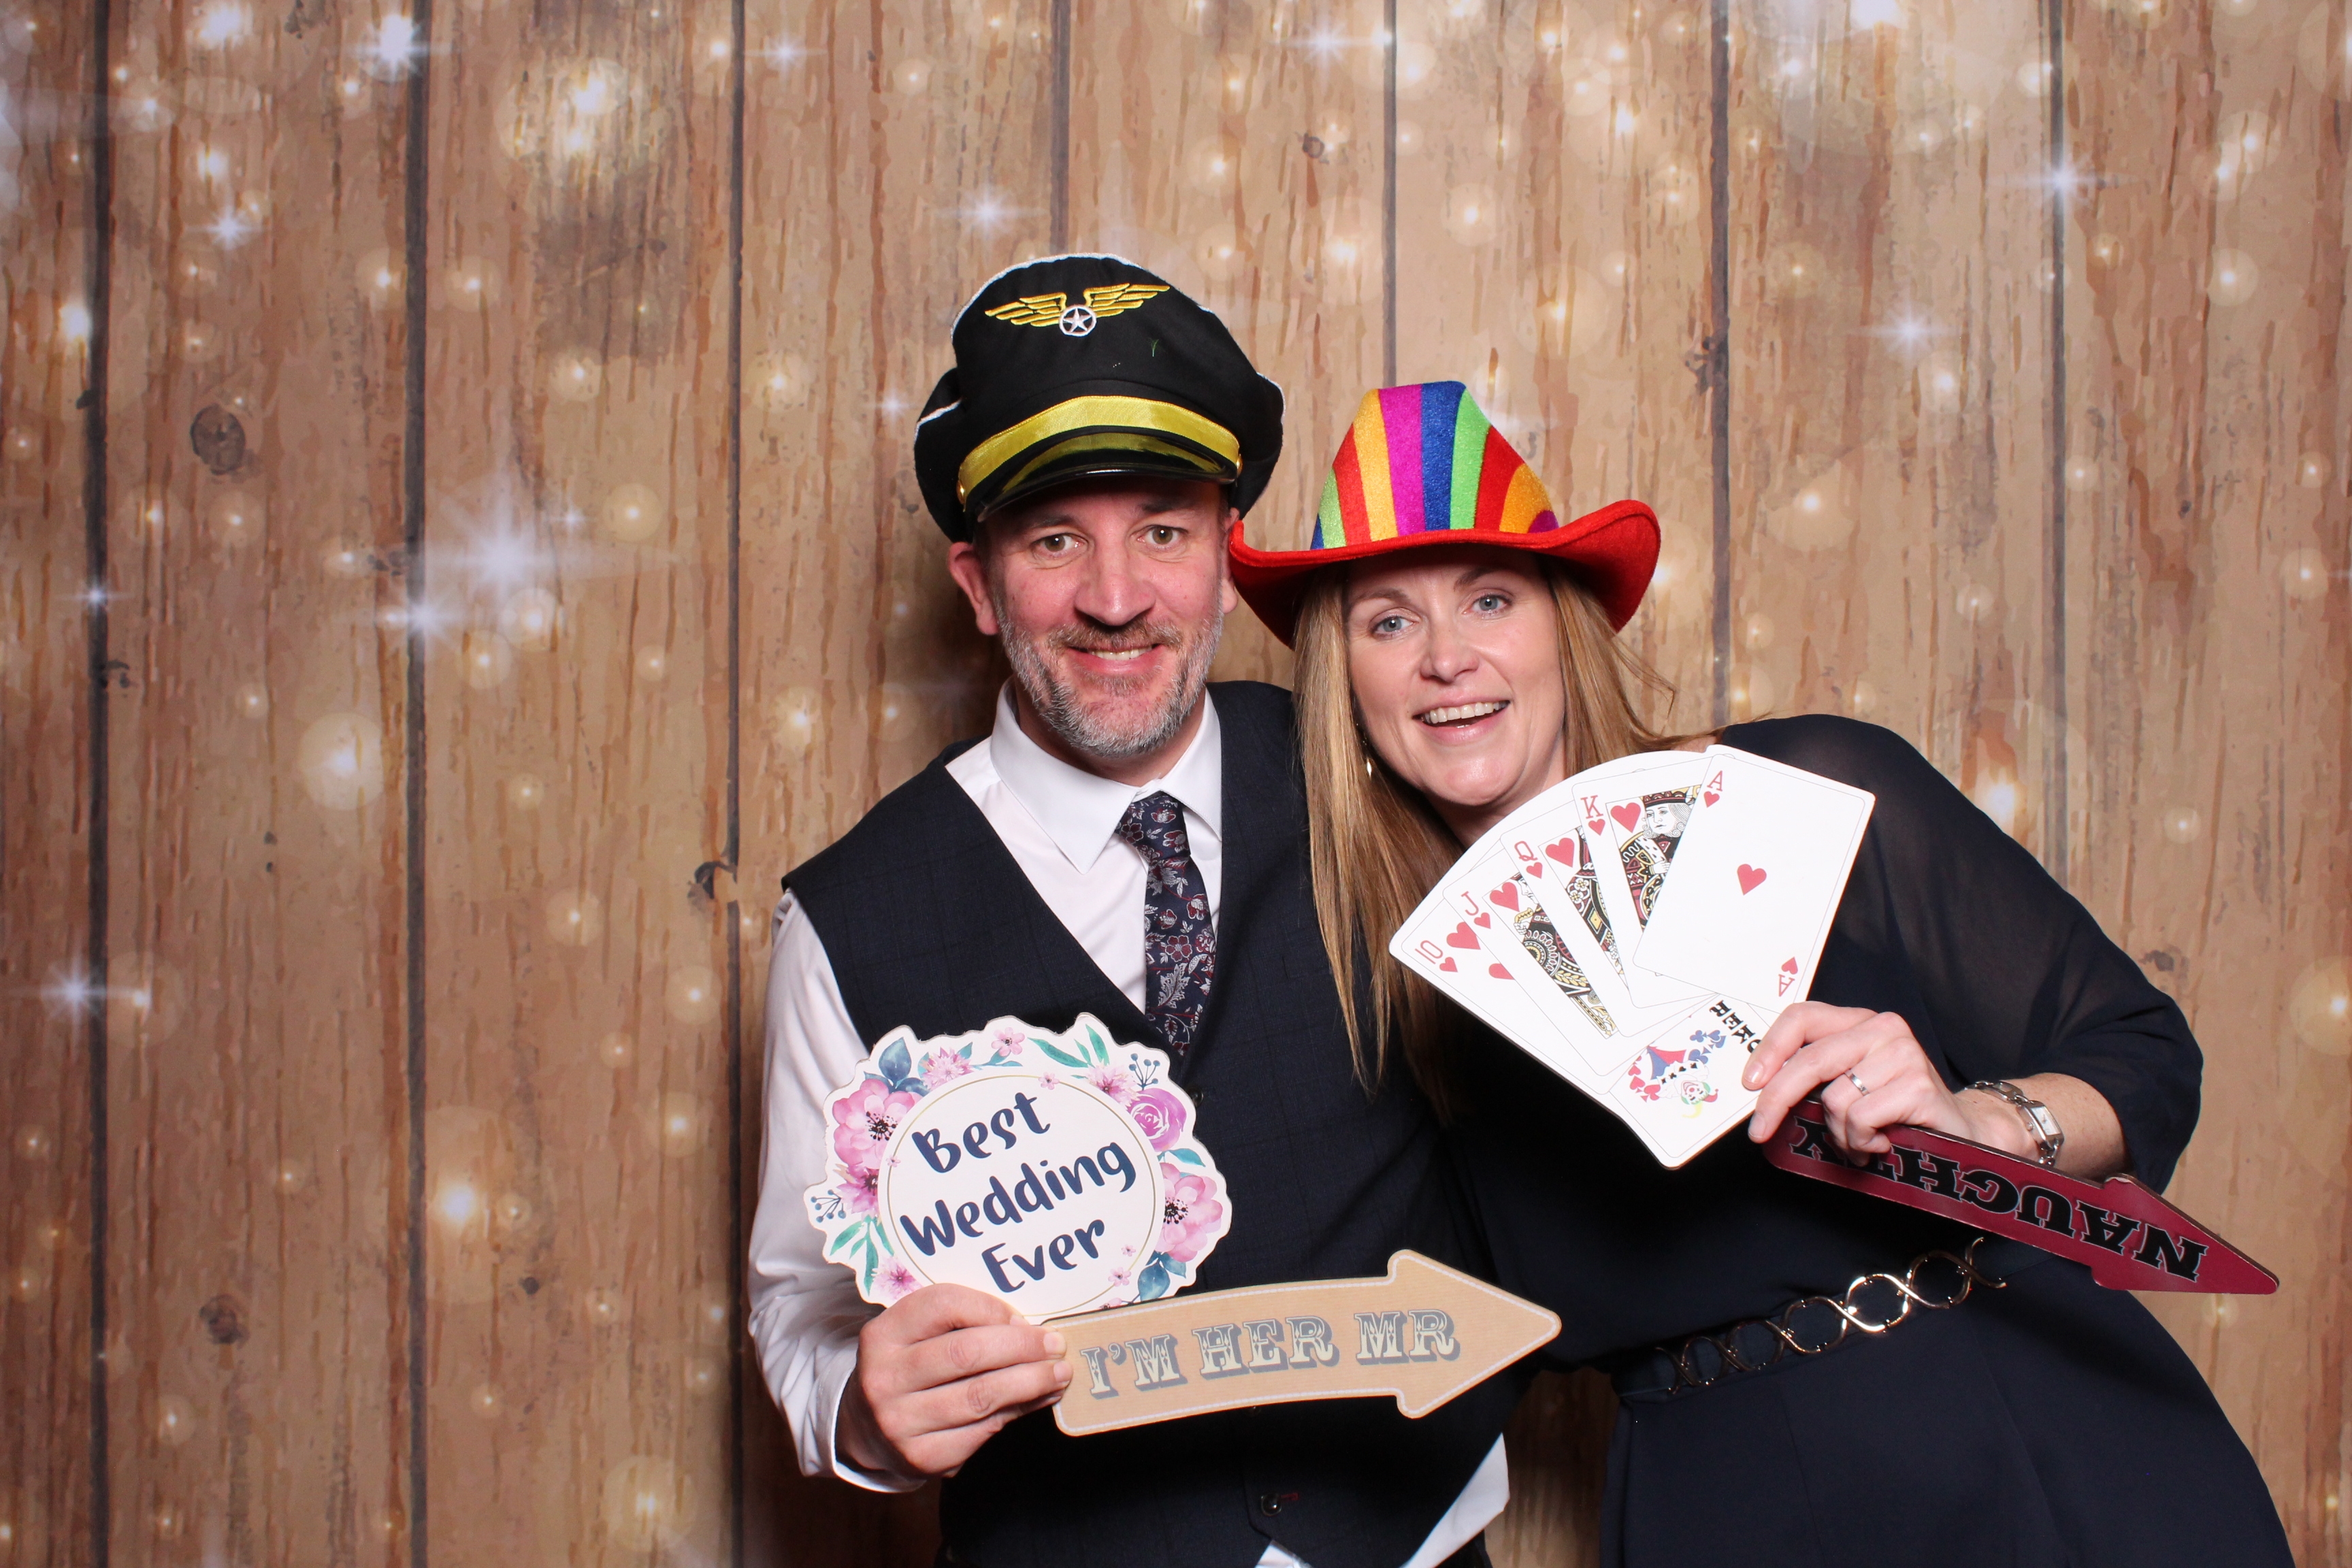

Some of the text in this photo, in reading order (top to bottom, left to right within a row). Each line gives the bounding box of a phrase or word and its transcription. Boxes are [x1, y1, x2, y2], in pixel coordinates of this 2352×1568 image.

[1706, 770, 1724, 792] A
[1580, 794, 1604, 819] K
[1514, 840, 1539, 862] Q
[1460, 890, 1480, 917] J
[1414, 939, 1444, 965] 10
[1778, 973, 1796, 998] A
[912, 1092, 1051, 1174] Best
[900, 1141, 1137, 1256] Wedding
[981, 1219, 1105, 1294] Ever
[1079, 1309, 1461, 1401] I'M HER MR
